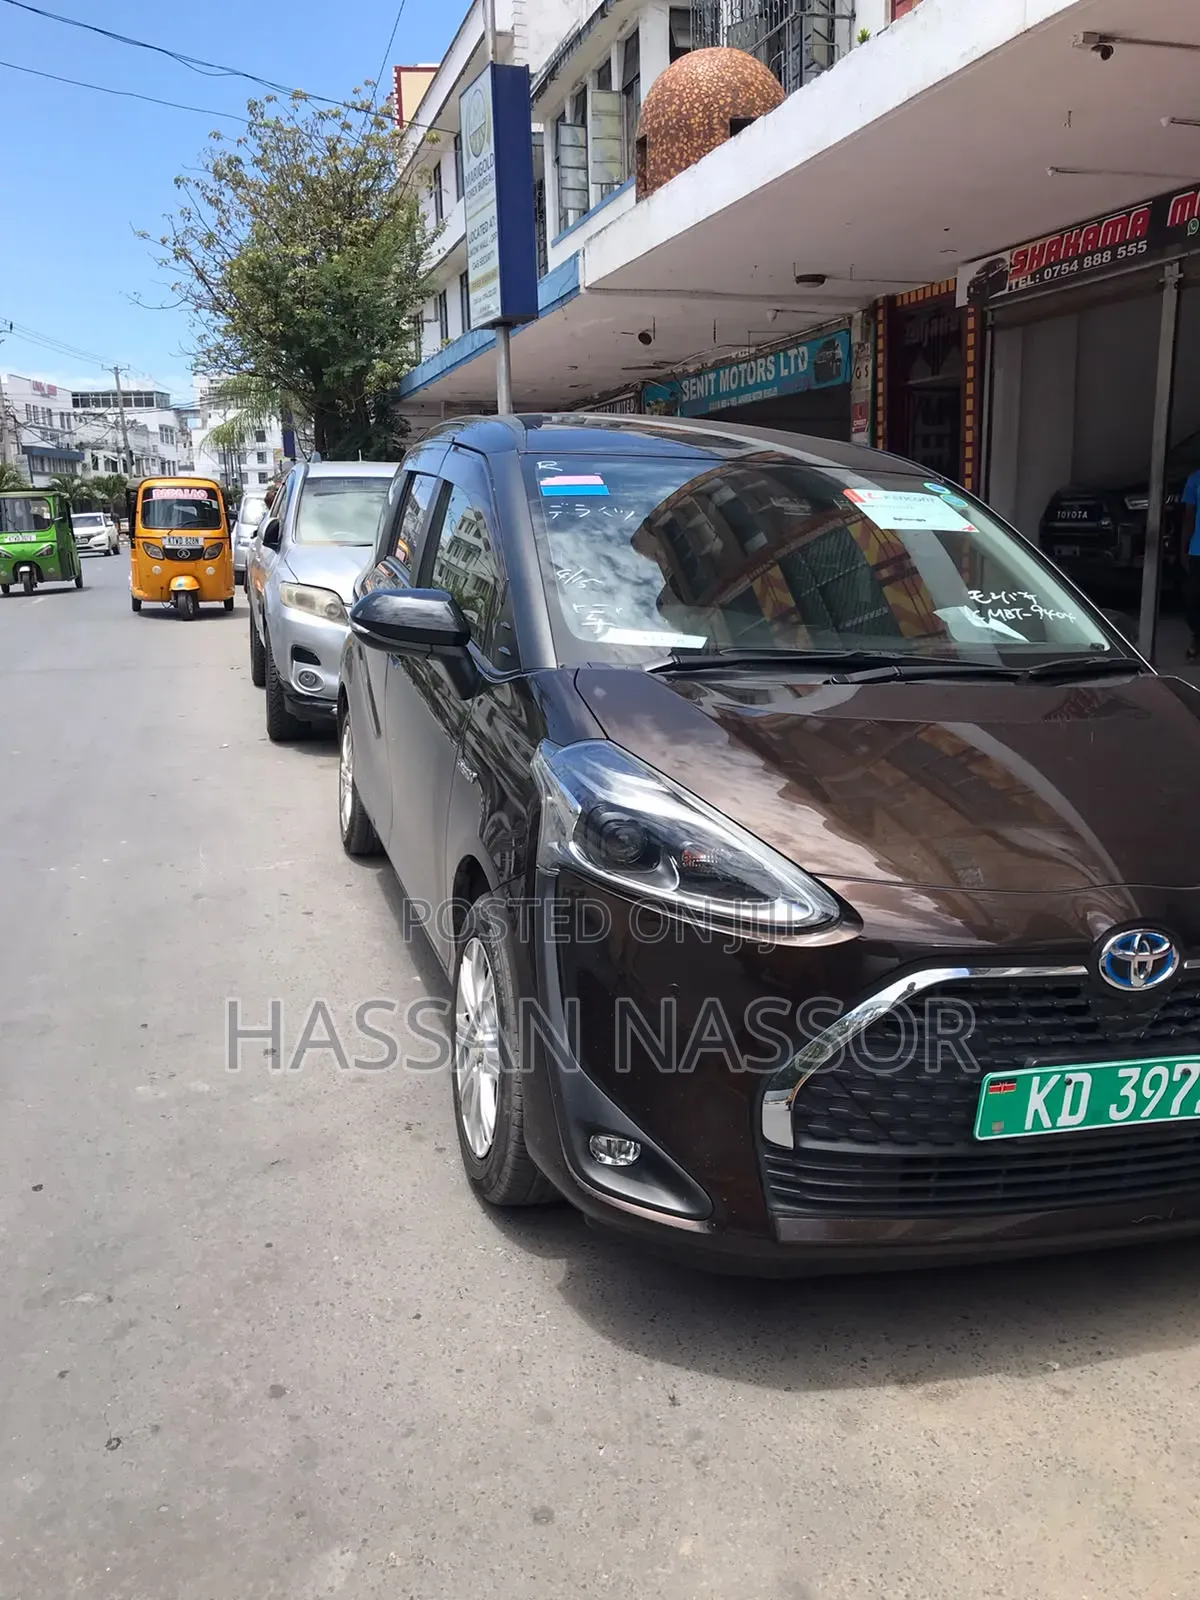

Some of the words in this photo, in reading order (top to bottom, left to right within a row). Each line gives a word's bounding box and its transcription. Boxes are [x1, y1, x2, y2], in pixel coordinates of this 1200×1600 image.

[465, 152, 495, 189] MARIGOLD
[468, 221, 489, 245] LOCATED
[1008, 207, 1151, 280] SHAKAMA
[1010, 274, 1040, 291] TEL:
[1043, 262, 1079, 280] 0754
[1083, 251, 1112, 269] 888
[1116, 240, 1148, 259] 555
[719, 355, 776, 393] MOTORS
[779, 346, 809, 377] LTD
[1056, 510, 1088, 519] TOYOTA
[1024, 1072, 1093, 1131] KD
[1109, 1063, 1200, 1121] 397
